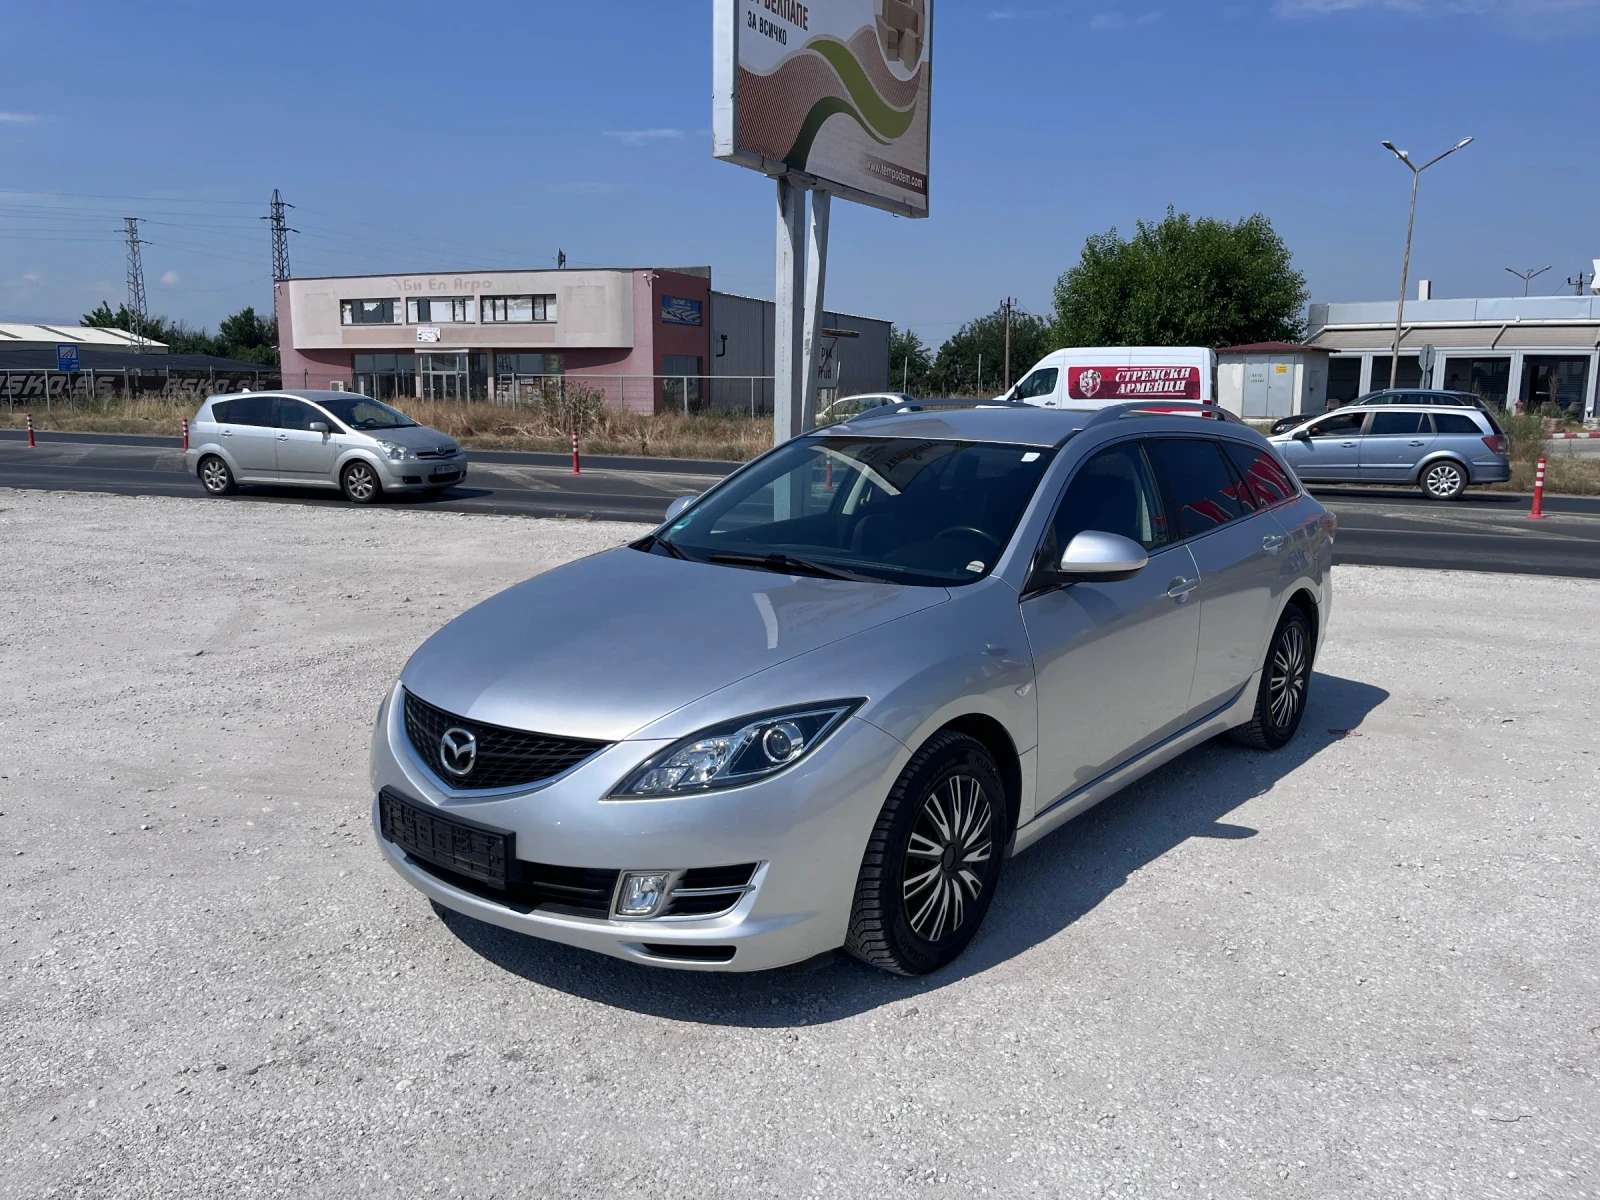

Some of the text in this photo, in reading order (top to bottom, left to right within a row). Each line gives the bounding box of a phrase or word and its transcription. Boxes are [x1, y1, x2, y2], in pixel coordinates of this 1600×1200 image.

[747, 10, 787, 45] ЗА ВСИЧКО
[454, 277, 492, 292] Агро
[1115, 367, 1191, 382] СТРЕМСКИ
[1116, 379, 1186, 394] АРМЕЙЦИ
